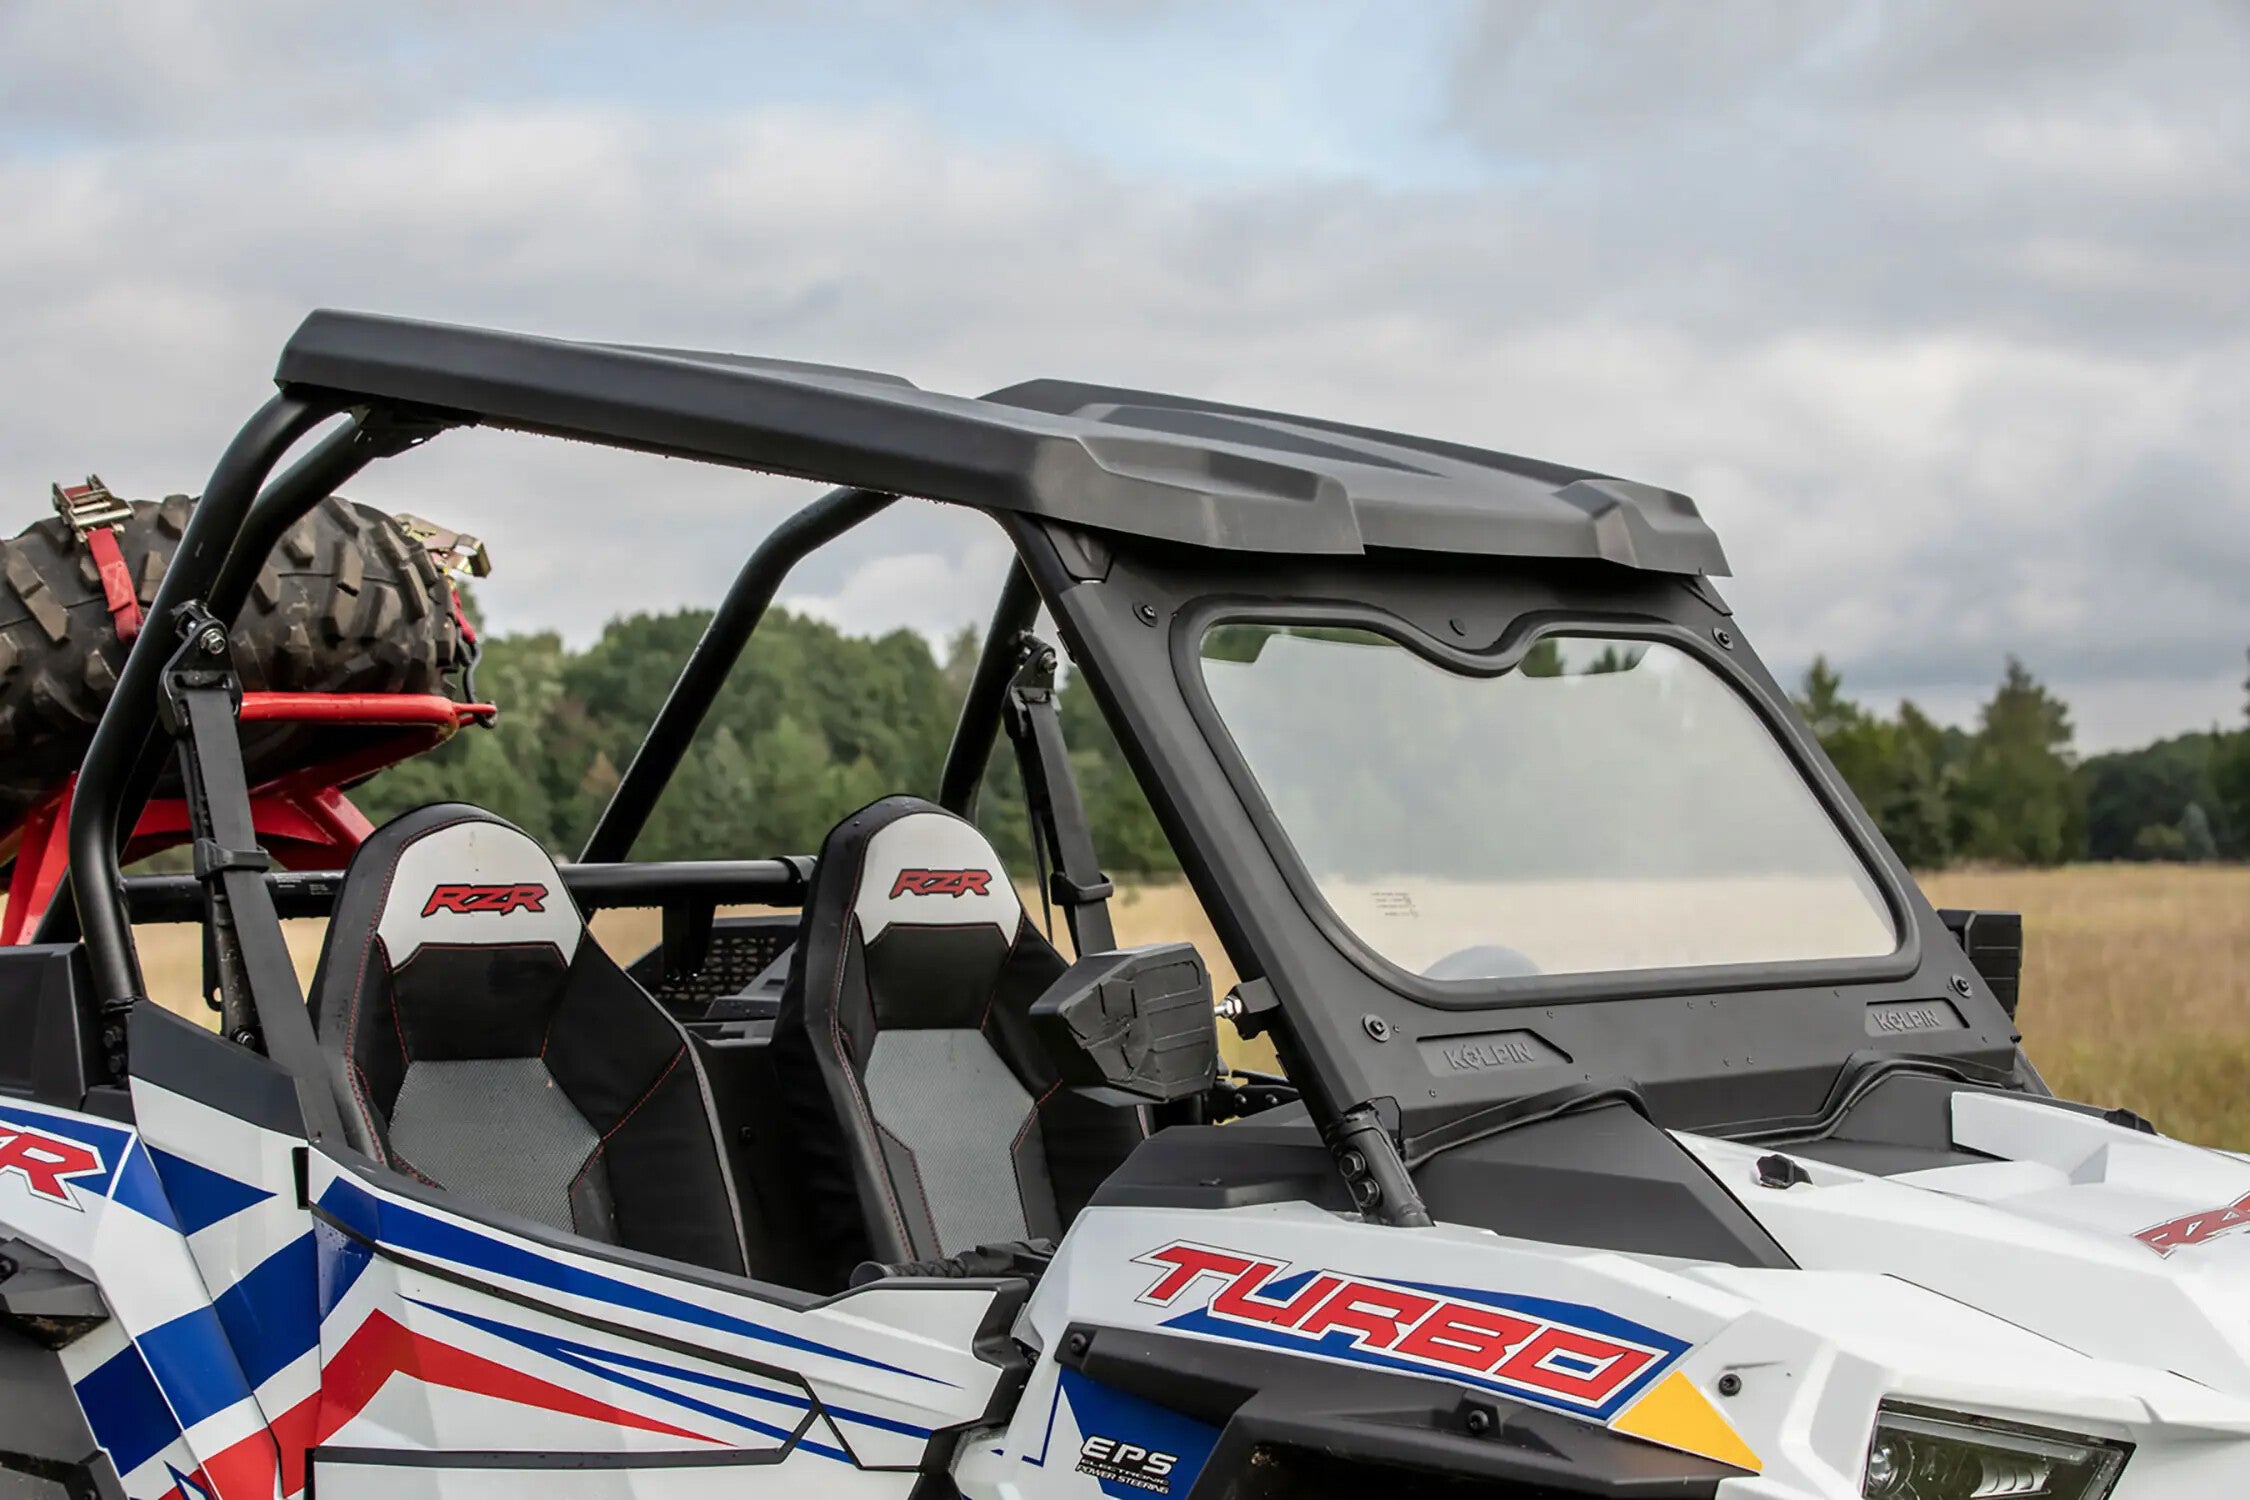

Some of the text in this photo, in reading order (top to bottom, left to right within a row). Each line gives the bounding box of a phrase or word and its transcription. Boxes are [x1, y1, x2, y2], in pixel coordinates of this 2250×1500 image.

[421, 883, 549, 918] RZR
[888, 869, 992, 900] RZR
[1443, 1043, 1535, 1071] KOLPIN
[2129, 1189, 2250, 1260] RZ
[1136, 1240, 1668, 1406] TURBO
[1081, 1435, 1178, 1476] EPS
[1077, 1464, 1169, 1494] POWER STEERING
[1080, 1459, 1170, 1486] ELECTRONIC
